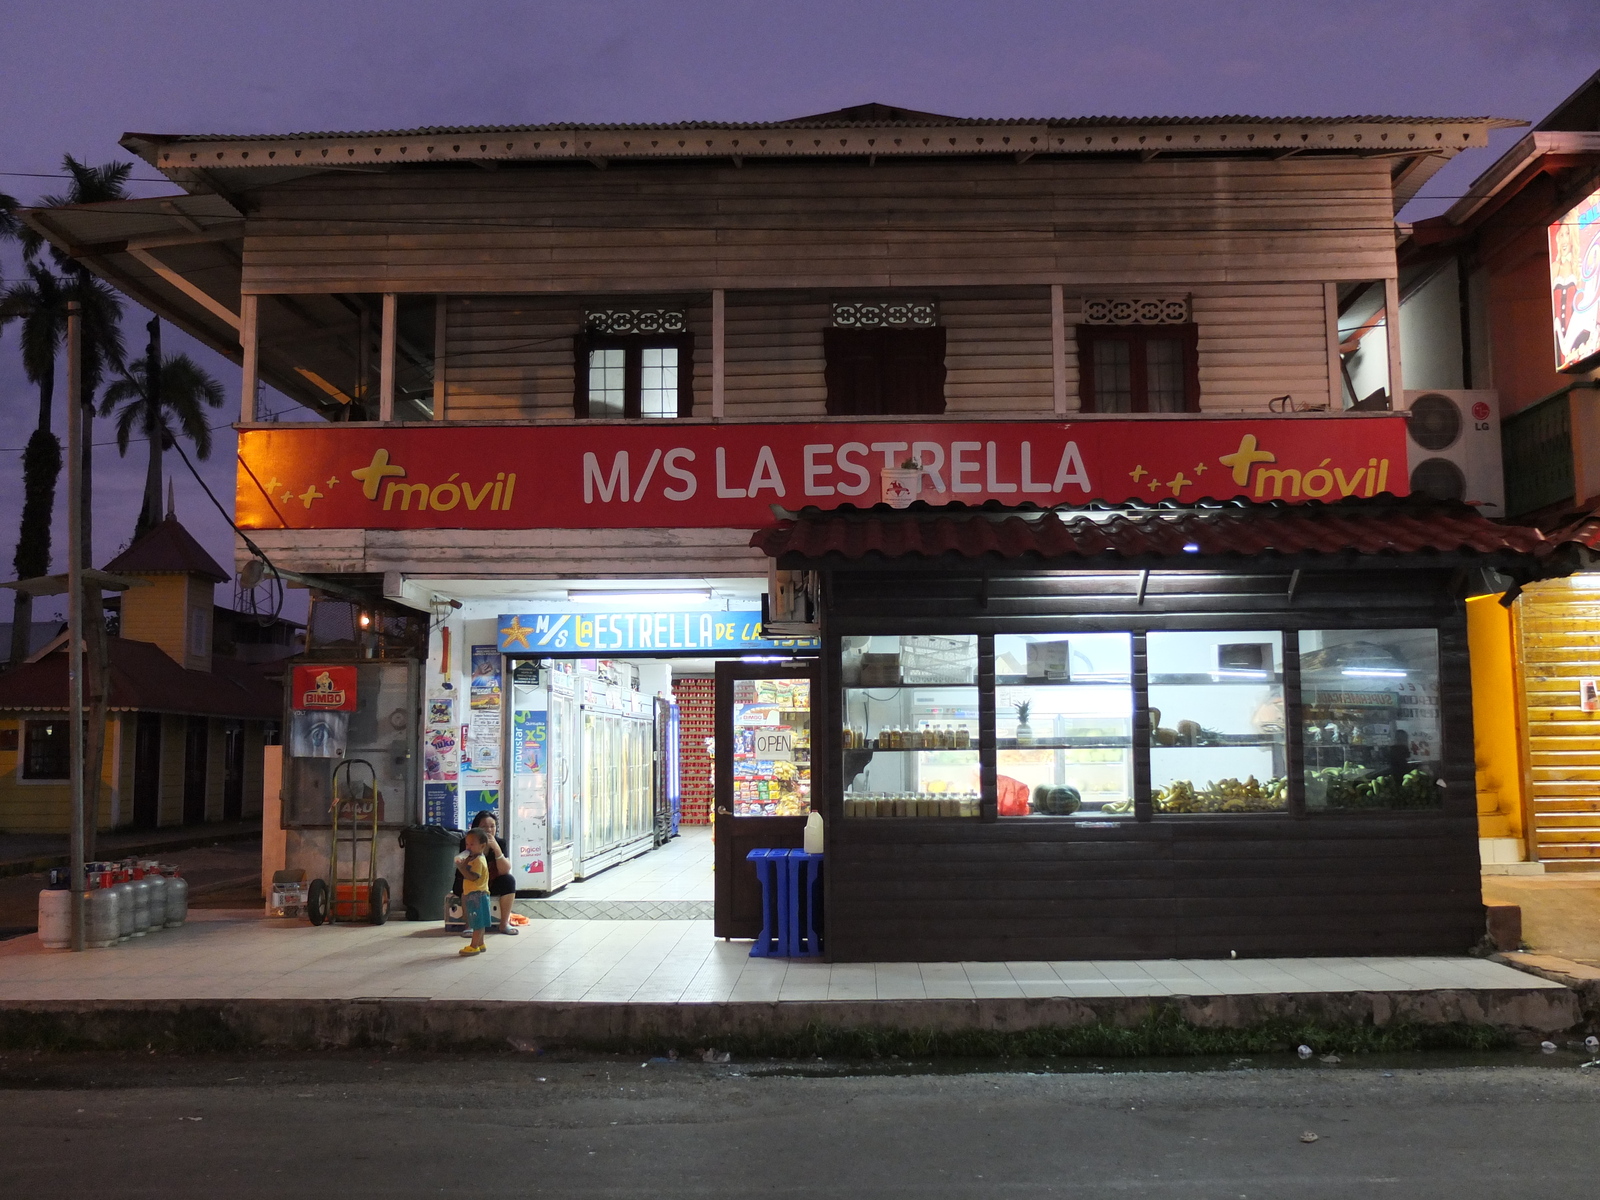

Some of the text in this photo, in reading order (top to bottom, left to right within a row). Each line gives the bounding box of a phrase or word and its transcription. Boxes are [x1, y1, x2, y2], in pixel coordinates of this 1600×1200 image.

[1475, 422, 1489, 431] LG
[583, 441, 1092, 503] M/S LA ESTRELLA
[535, 615, 571, 648] M/S
[595, 613, 713, 648] ESTRELLA
[715, 623, 736, 640] DE
[741, 622, 762, 640] LA
[306, 694, 342, 703] BIMBO
[525, 726, 546, 741] x5
[515, 727, 523, 771] movistar
[757, 734, 791, 752] OPEN
